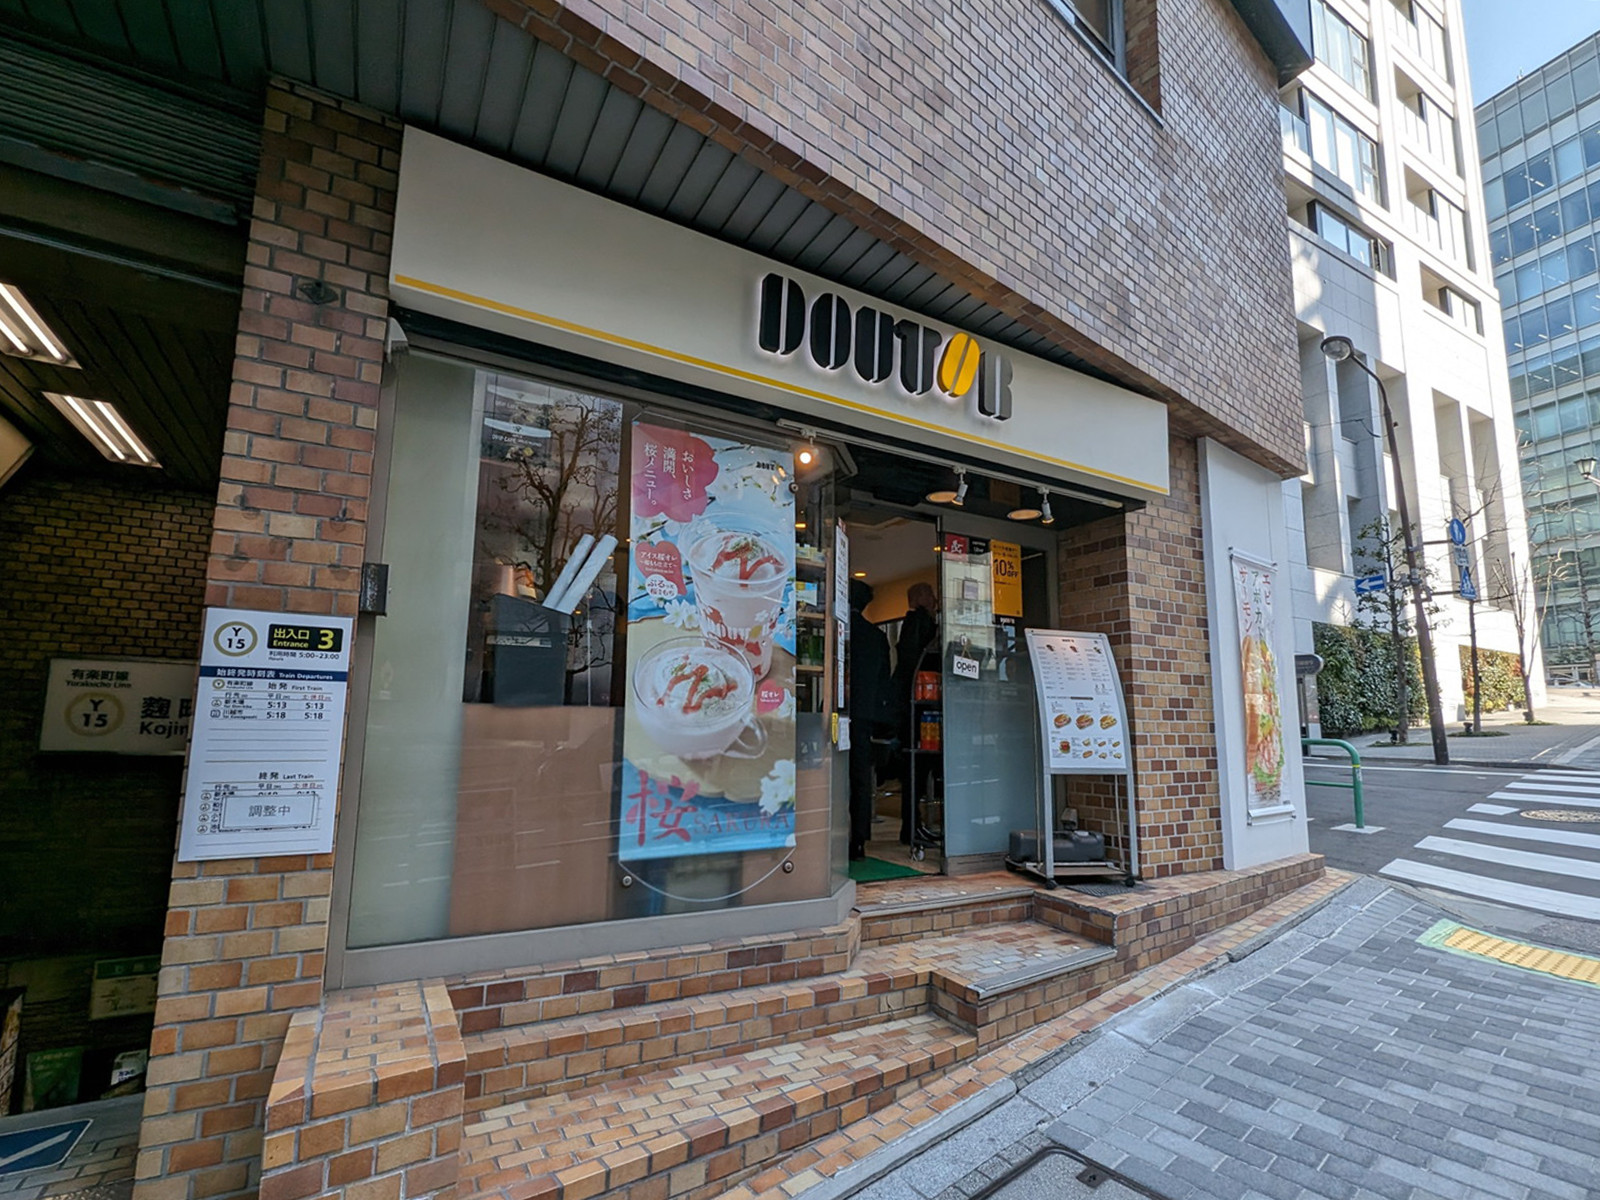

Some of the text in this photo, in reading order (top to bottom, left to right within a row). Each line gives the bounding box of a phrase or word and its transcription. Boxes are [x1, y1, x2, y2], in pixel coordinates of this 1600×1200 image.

[758, 272, 1014, 422] DOUTOR
[232, 628, 242, 637] Y
[227, 638, 245, 649] 15
[273, 628, 334, 650] 出入口 3
[273, 640, 309, 648] Entrance
[956, 661, 977, 673] open
[216, 668, 276, 678] 始終発時刻表
[297, 673, 333, 681] Departures
[89, 699, 104, 711] Y
[267, 701, 287, 709] 5:13
[305, 702, 324, 710] 5:13
[82, 713, 108, 728] 15
[266, 711, 286, 719] 5:18
[304, 712, 323, 720] 5:18
[248, 805, 291, 817] 調整中
[625, 769, 699, 848] 桜
